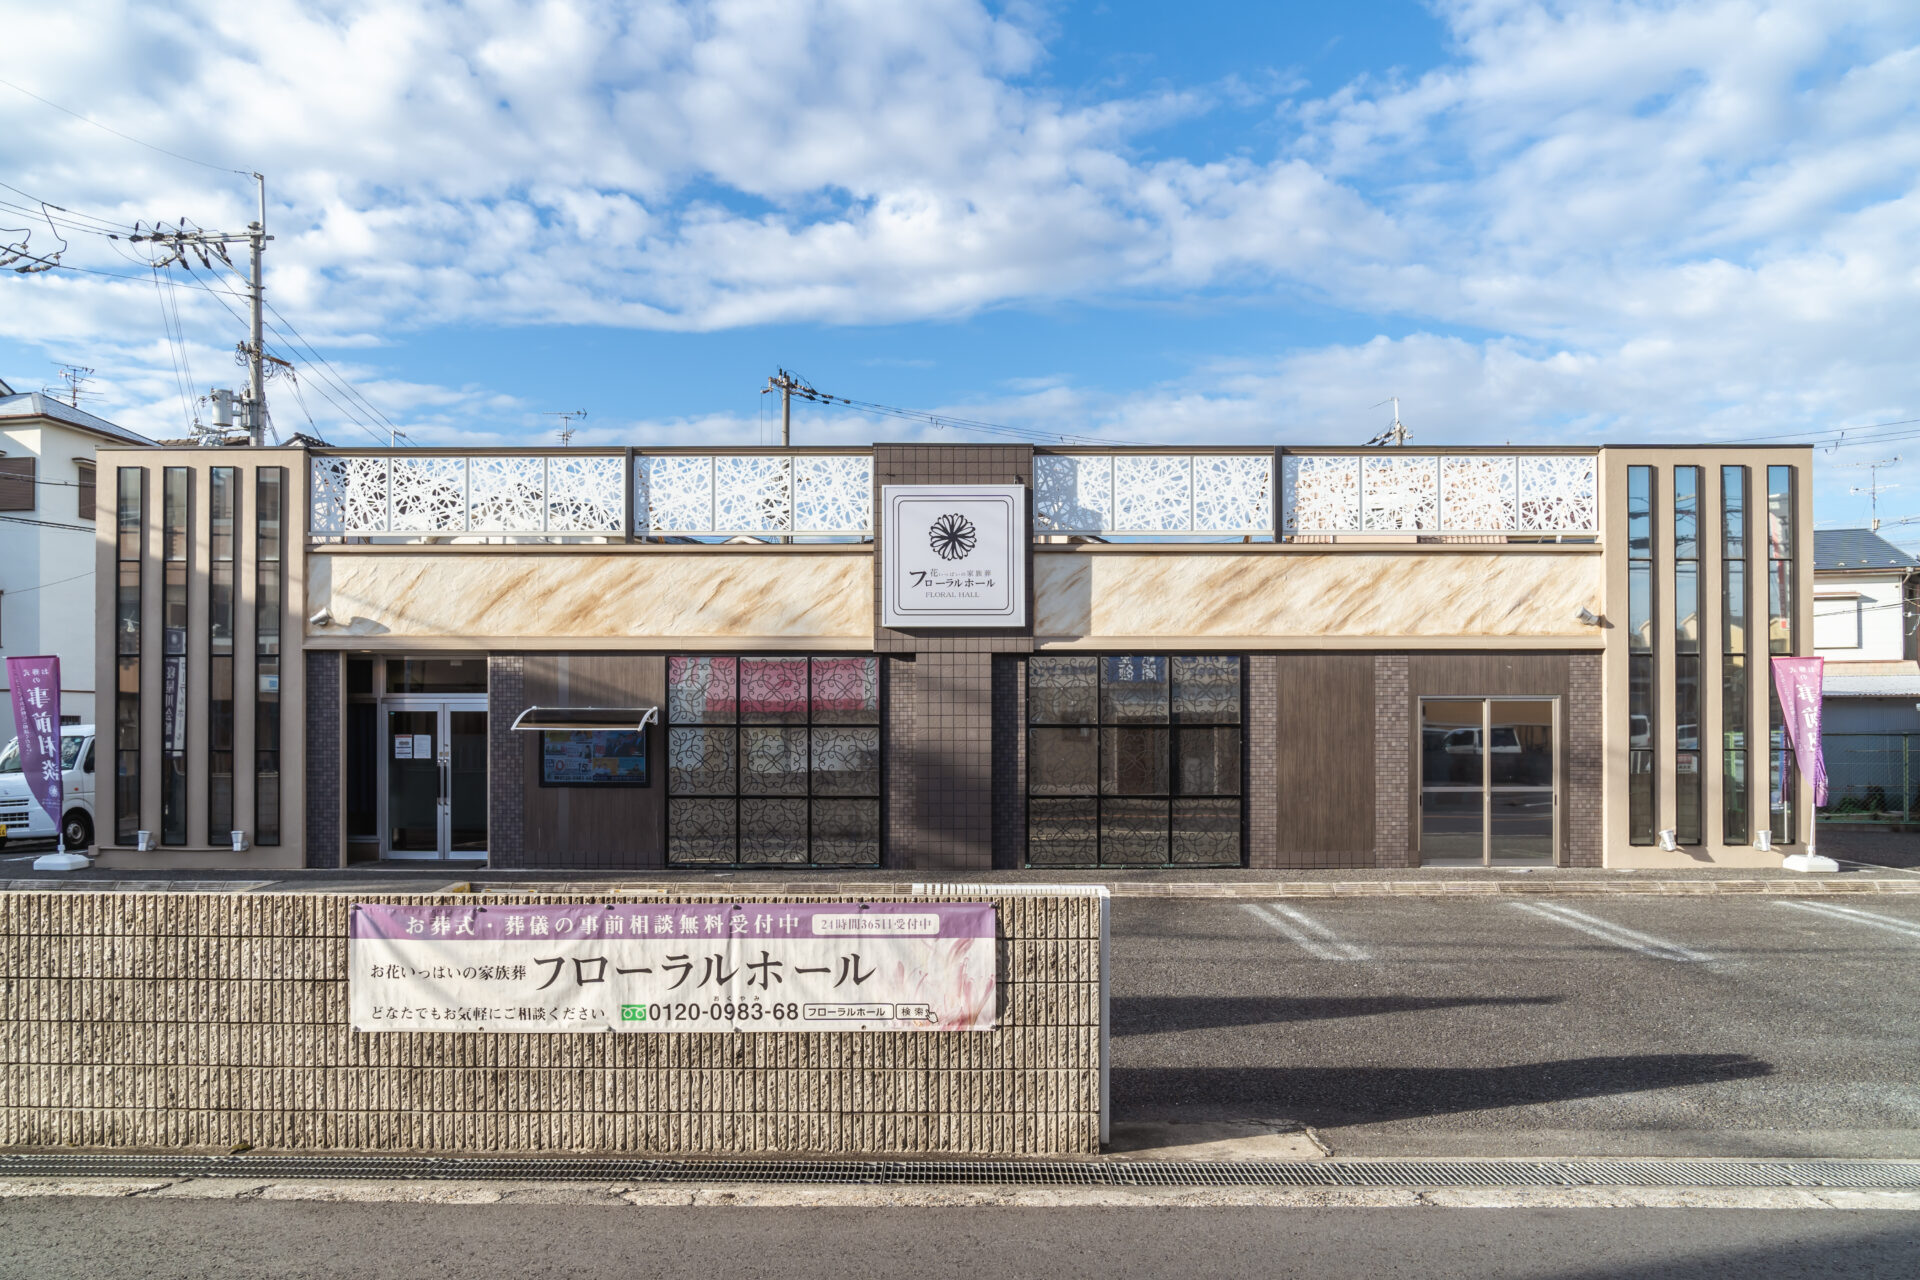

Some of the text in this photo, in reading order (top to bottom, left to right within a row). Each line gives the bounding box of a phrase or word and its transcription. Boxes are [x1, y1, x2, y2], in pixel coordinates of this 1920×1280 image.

[909, 570, 996, 588] フローラルホール
[406, 914, 800, 935] お葬式・葬儀の事前相談無料受付中
[821, 917, 932, 930] 24時間365日受付中
[371, 964, 527, 981] お花いっぱいの家族葬
[534, 950, 877, 991] フローラルホール
[371, 1005, 605, 1021] どなたでもお気軽にご相談ください
[649, 1003, 799, 1021] 0120-0983-68
[807, 1007, 886, 1017] フローラルホール
[901, 1007, 924, 1017] 検索
